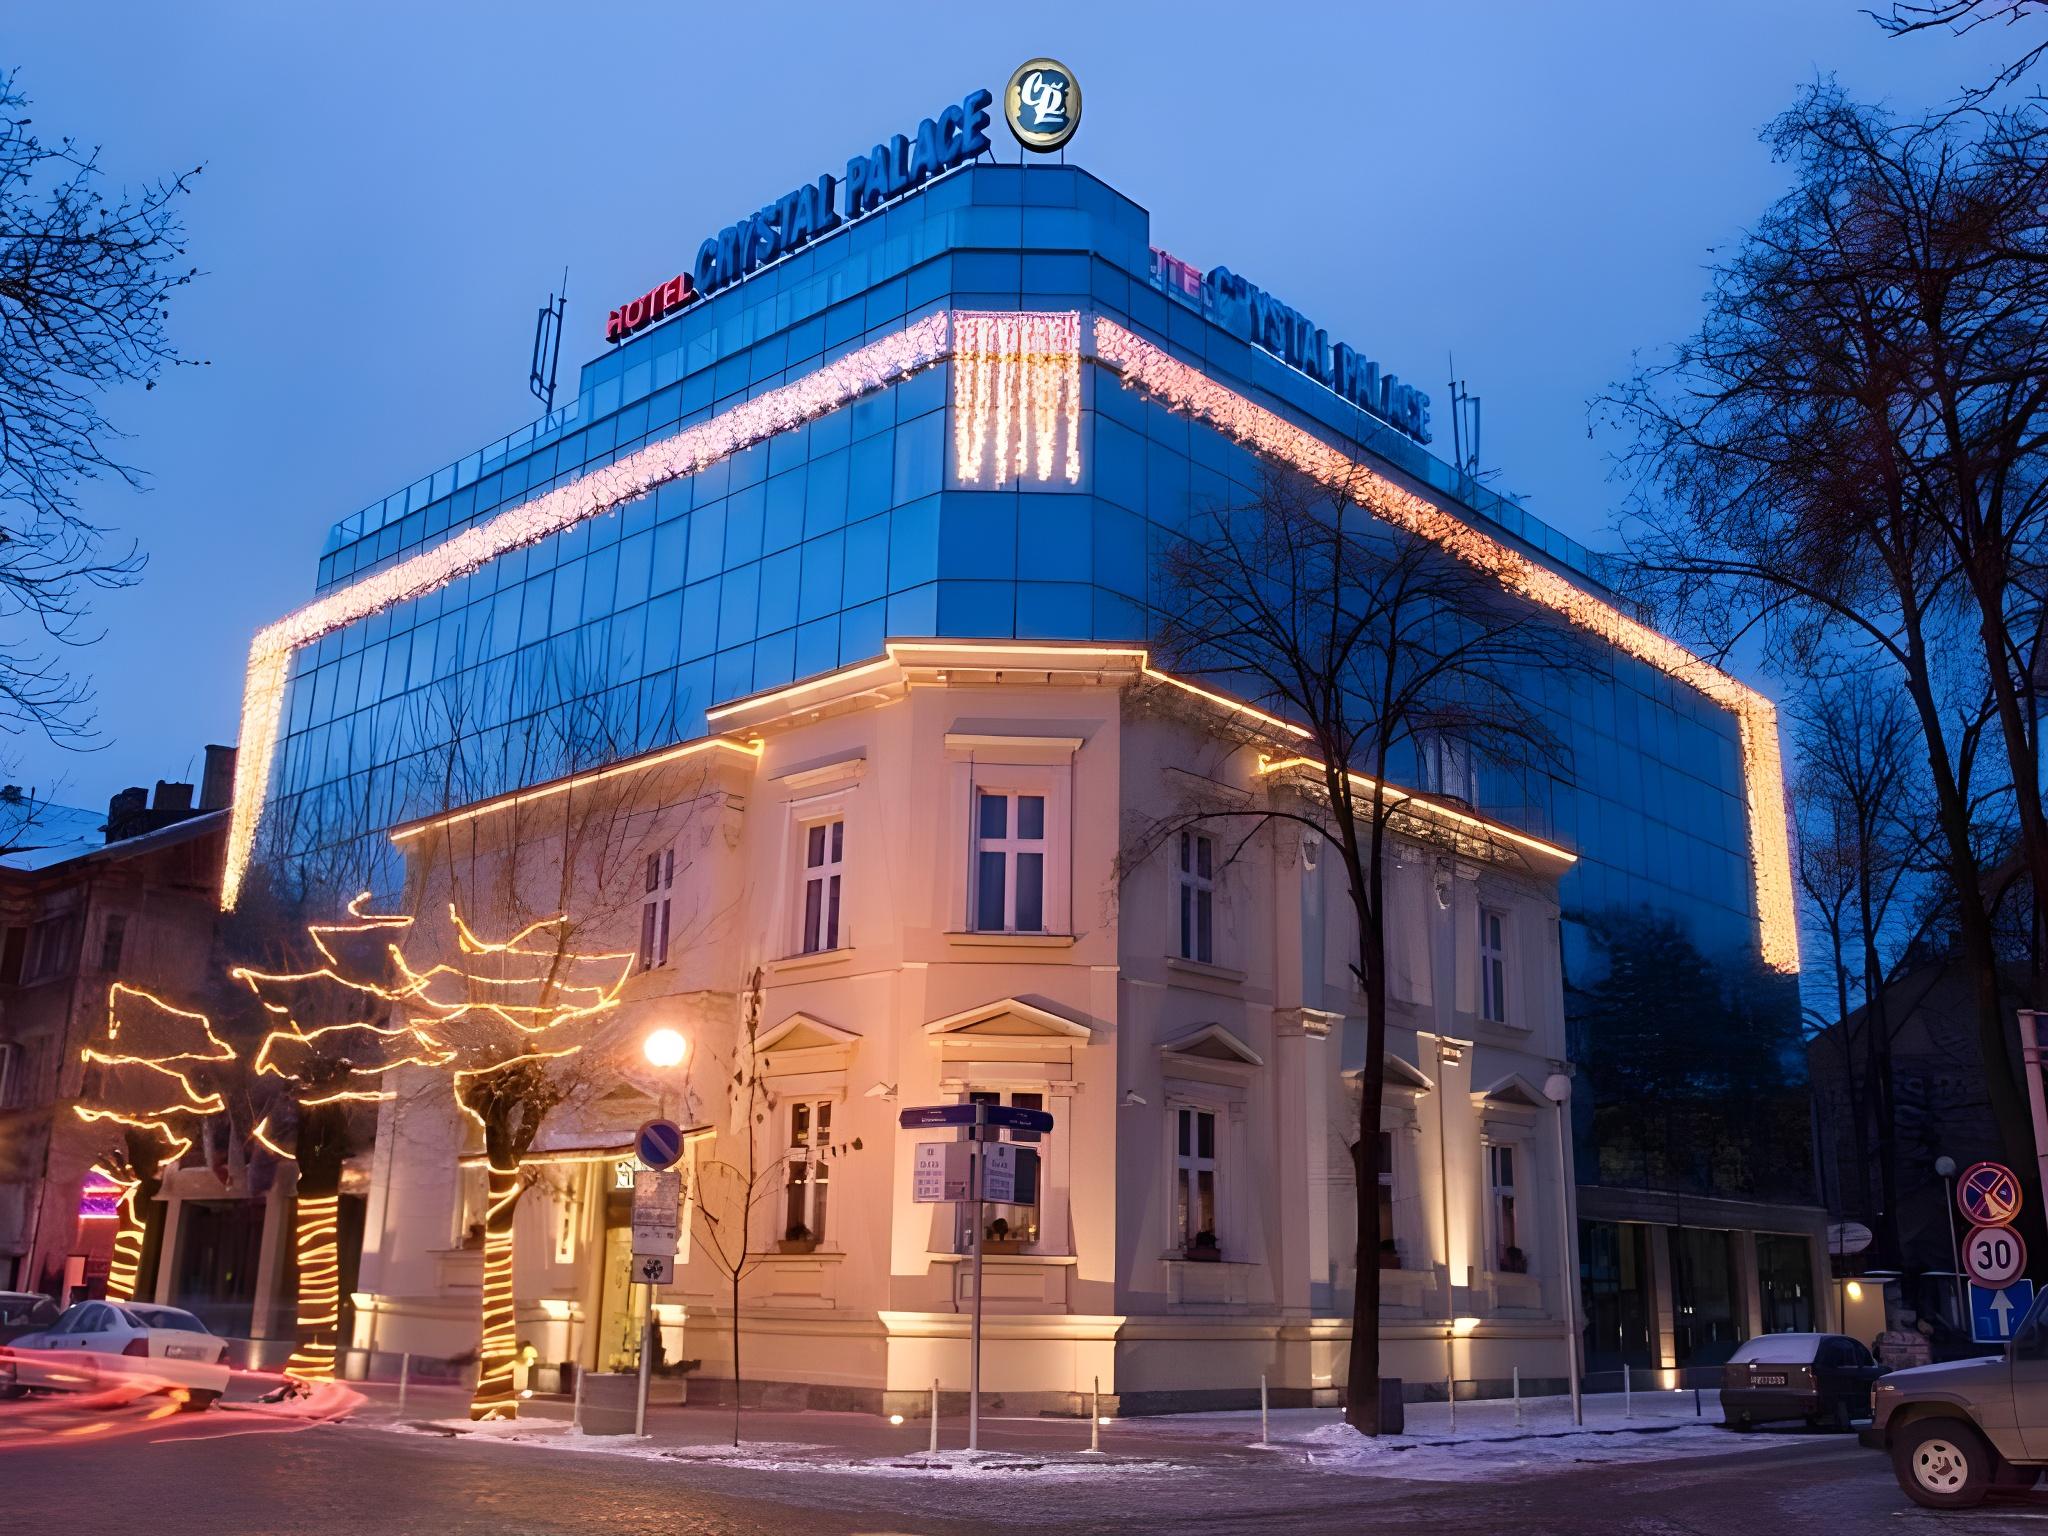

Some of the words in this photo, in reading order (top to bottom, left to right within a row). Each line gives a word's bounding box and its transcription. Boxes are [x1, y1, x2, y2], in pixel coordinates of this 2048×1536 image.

[605, 271, 695, 344] HOTEL
[845, 88, 993, 218] PALACE
[1976, 1239, 2011, 1270] 30
